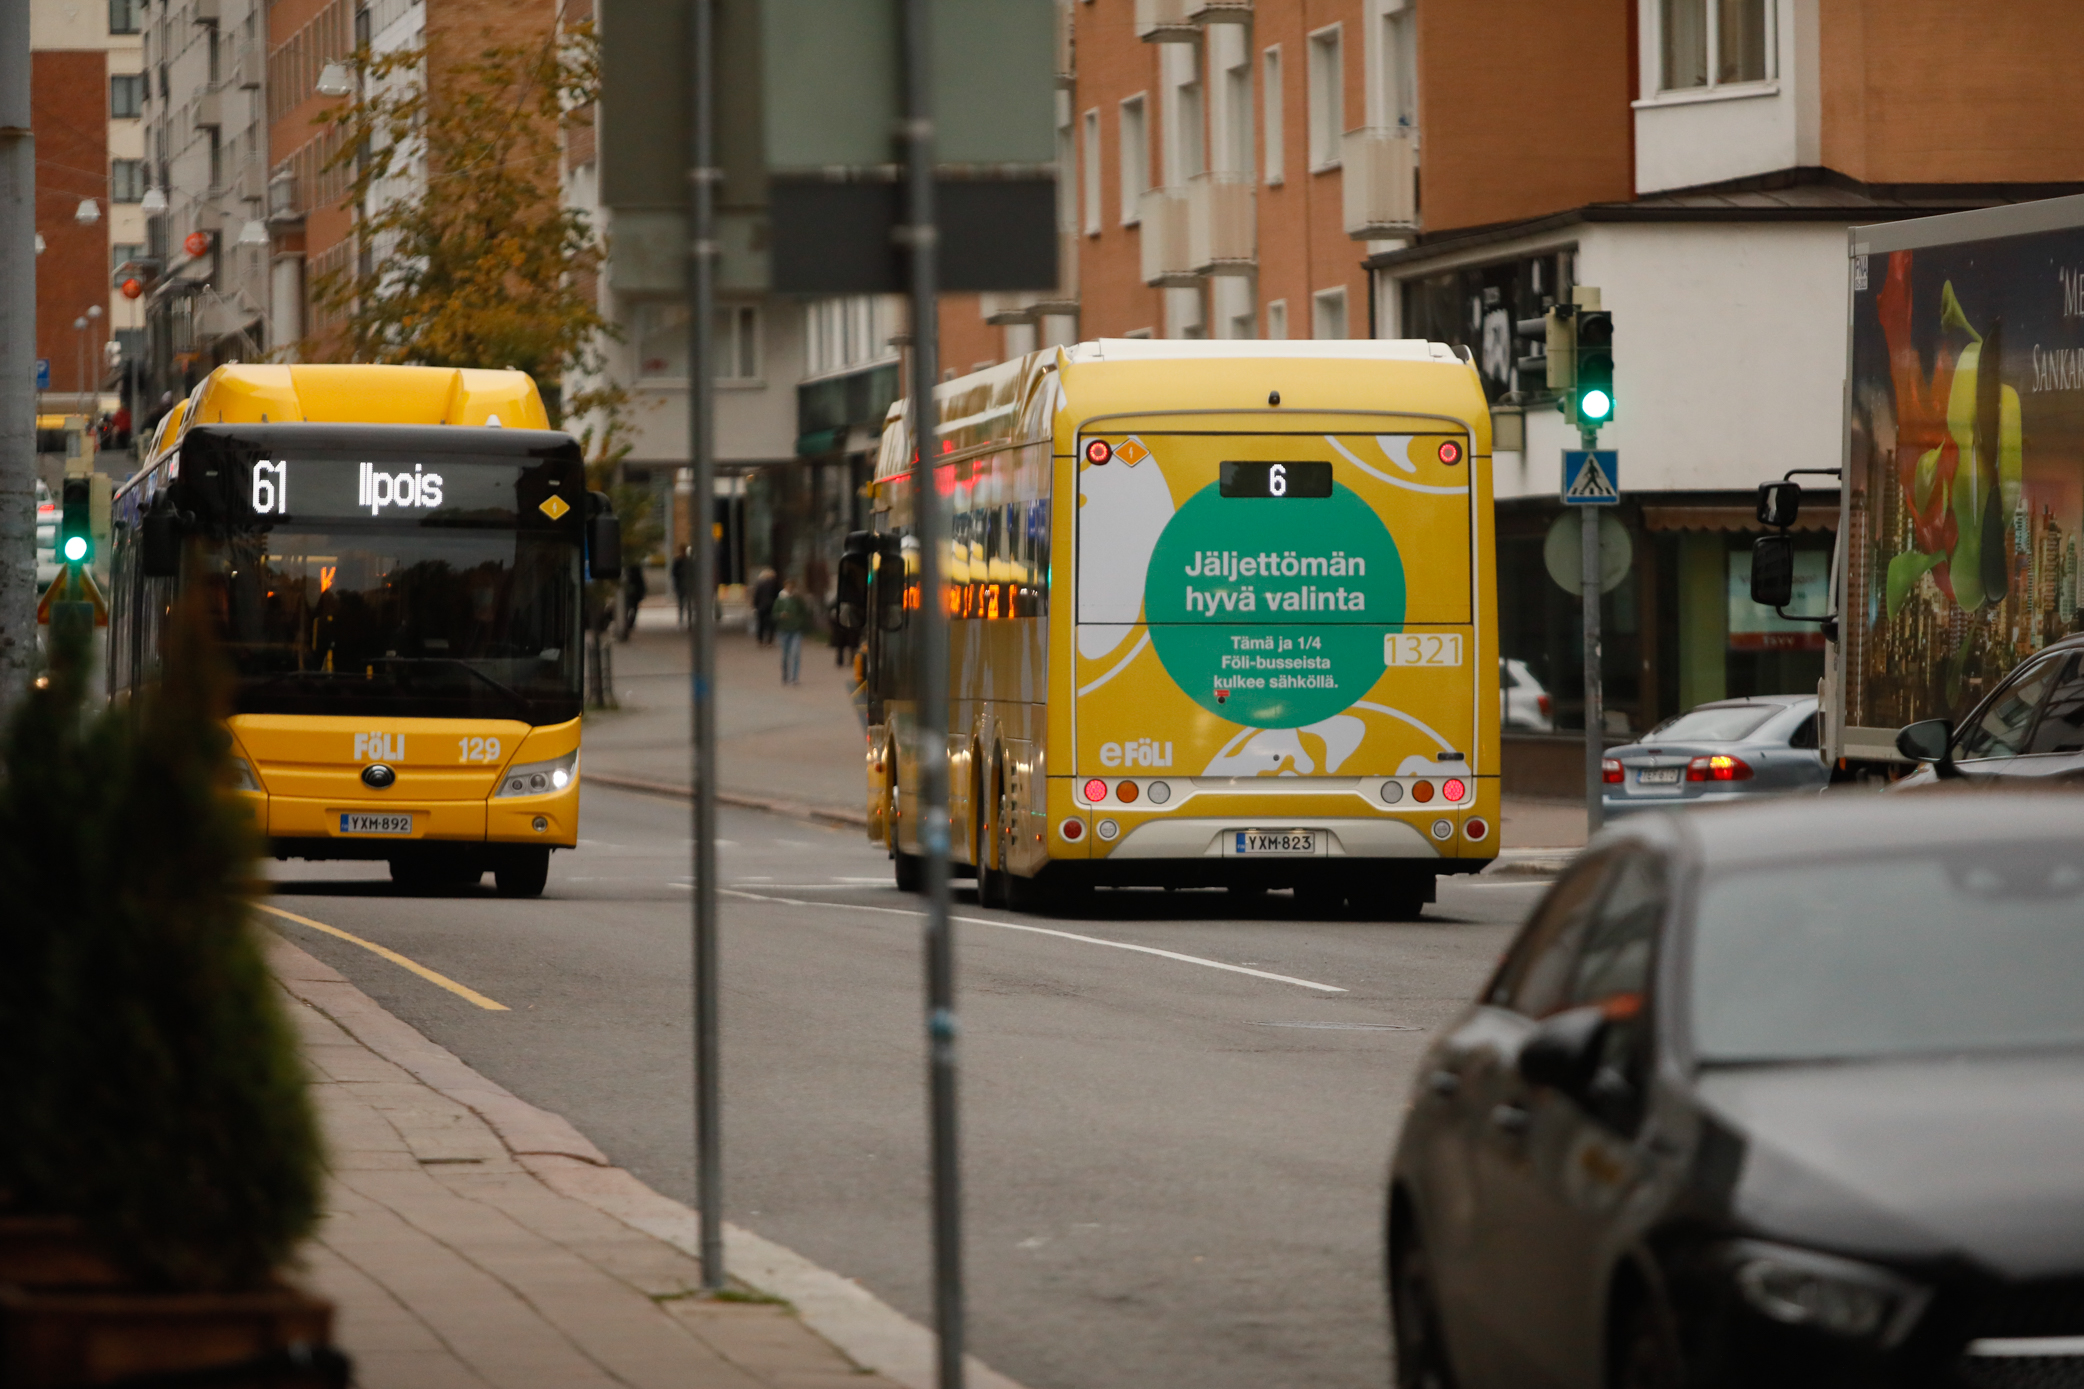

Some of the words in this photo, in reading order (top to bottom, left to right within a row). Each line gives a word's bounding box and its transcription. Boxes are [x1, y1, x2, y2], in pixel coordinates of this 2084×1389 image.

[253, 460, 286, 514] 61
[359, 462, 443, 516] Ilpois
[1269, 464, 1286, 496] 6
[1185, 551, 1366, 582] Jäljettömän
[1186, 586, 1256, 617] hyvä
[1264, 586, 1366, 612] valinta
[1231, 636, 1275, 650] Tämä
[1278, 636, 1293, 653] ja
[1297, 636, 1322, 650] 1/4
[1385, 636, 1459, 665] 1321
[1221, 655, 1331, 670] Föli-busseista
[1214, 675, 1266, 689] kulkee
[1269, 675, 1338, 689] sähköllä.
[353, 731, 405, 761] FÖLI
[458, 736, 501, 762] 129
